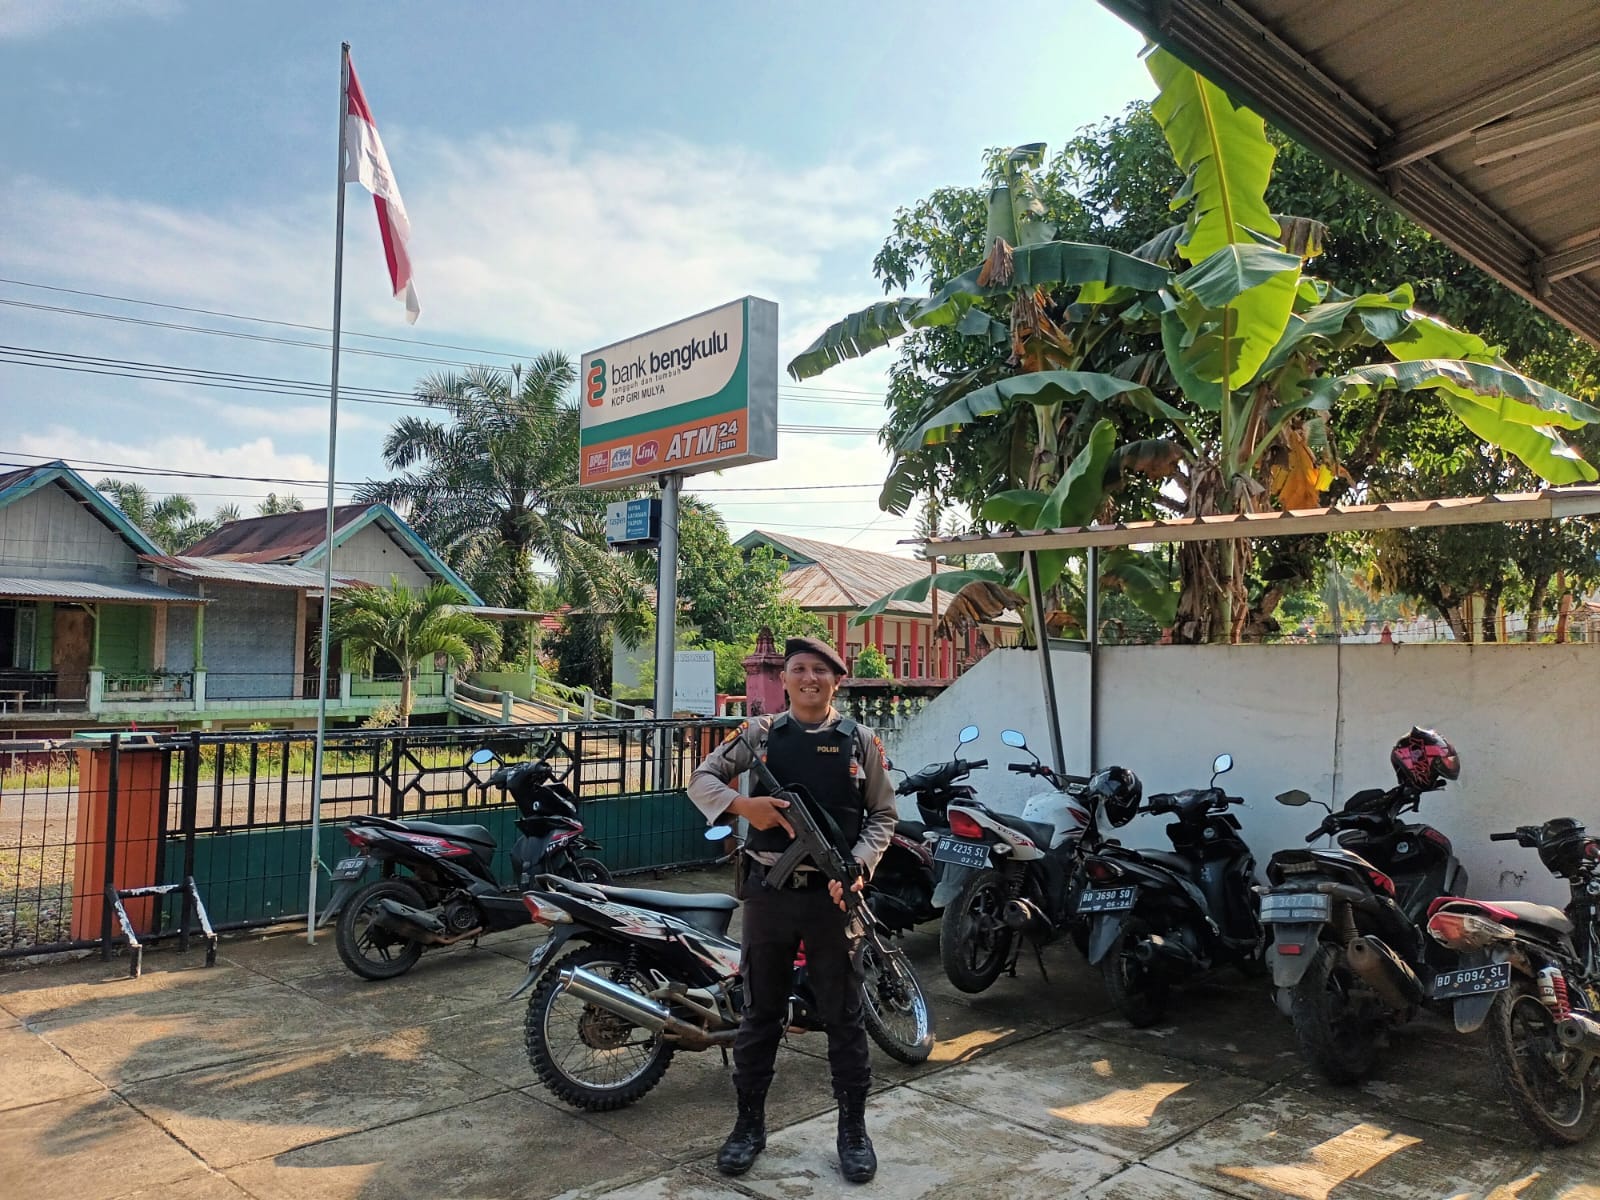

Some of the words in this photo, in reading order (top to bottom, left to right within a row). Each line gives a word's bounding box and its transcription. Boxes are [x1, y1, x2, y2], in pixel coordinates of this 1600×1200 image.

[612, 355, 646, 386] bank
[650, 330, 728, 370] bengkulu
[612, 380, 638, 394] tangguh
[641, 374, 654, 386] dan
[656, 368, 681, 382] tumbuh
[611, 394, 625, 408] KCP
[626, 390, 640, 404] GIRI
[641, 384, 665, 400] MULYA
[719, 420, 738, 438] 24
[637, 444, 658, 460] Link
[664, 424, 718, 462] ATM
[717, 439, 736, 453] jam
[939, 840, 950, 850] BD
[952, 844, 972, 856] 4235
[974, 848, 984, 858] SL
[1082, 892, 1093, 902] BD
[1096, 891, 1116, 900] 3690
[1437, 975, 1450, 987] BD
[1457, 970, 1484, 984] 6094
[1490, 966, 1504, 978] SL
